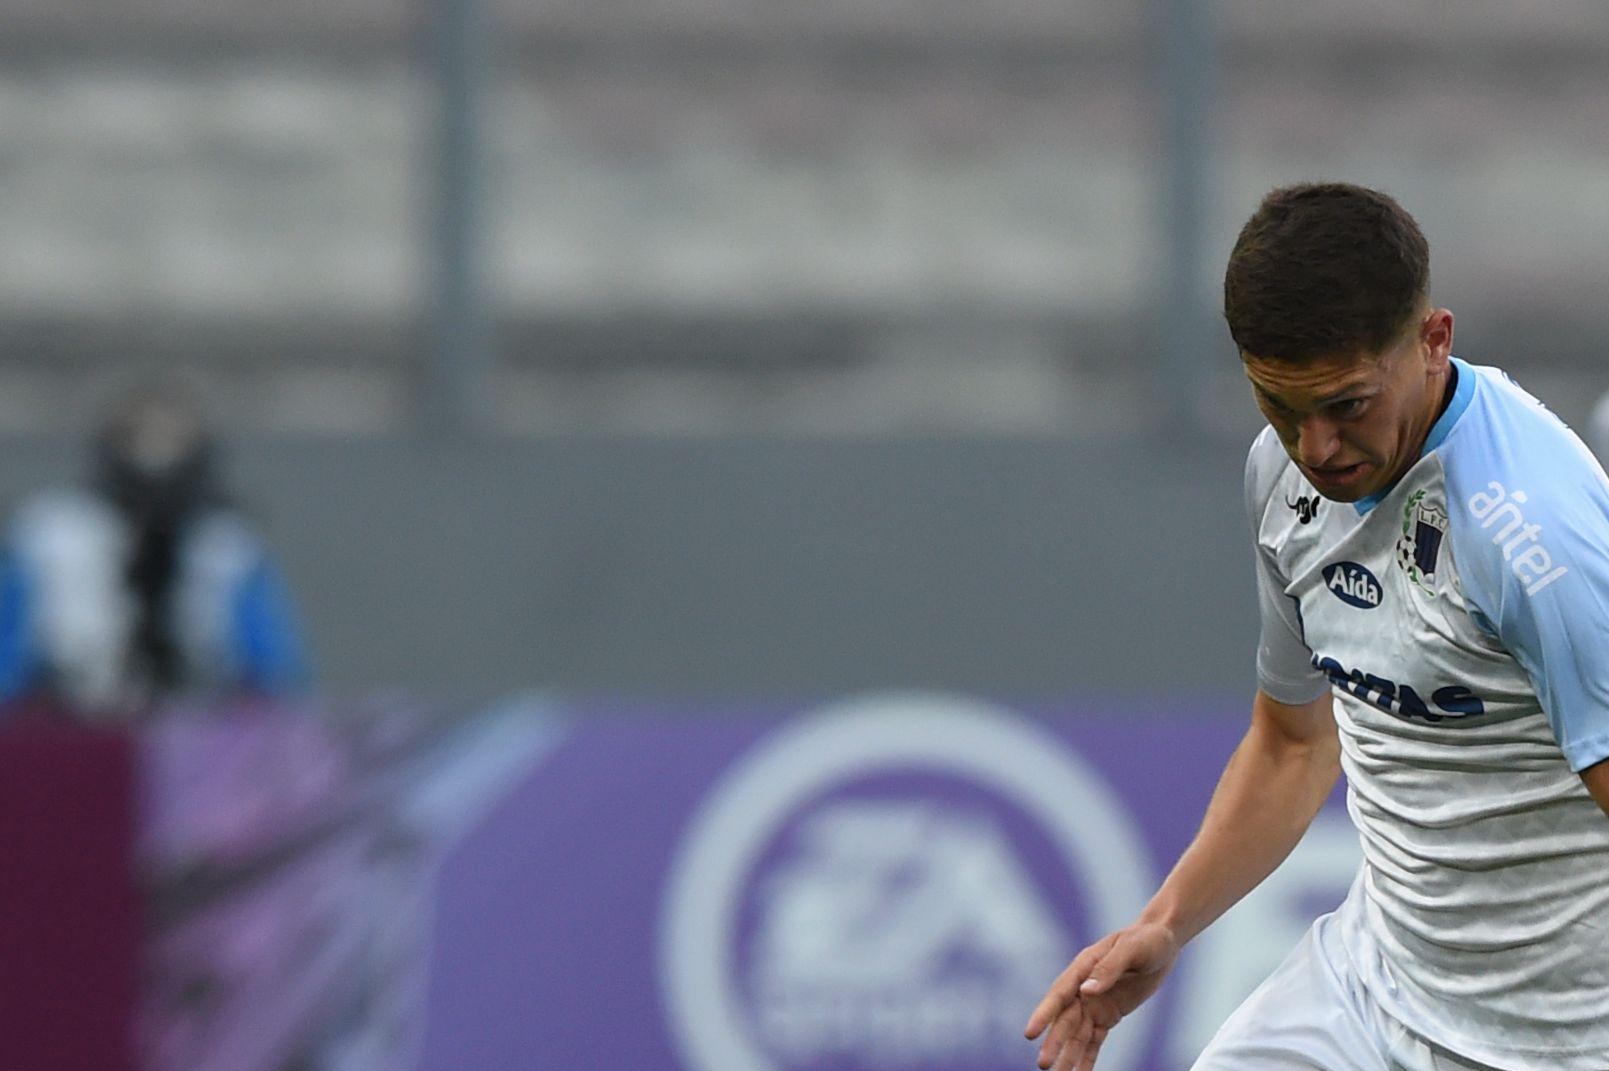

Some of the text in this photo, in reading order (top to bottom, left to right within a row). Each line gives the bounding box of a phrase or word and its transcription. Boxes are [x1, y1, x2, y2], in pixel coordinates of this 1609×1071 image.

[1328, 565, 1379, 605] Aída
[1468, 481, 1568, 597] antel
[765, 805, 1062, 988] EA
